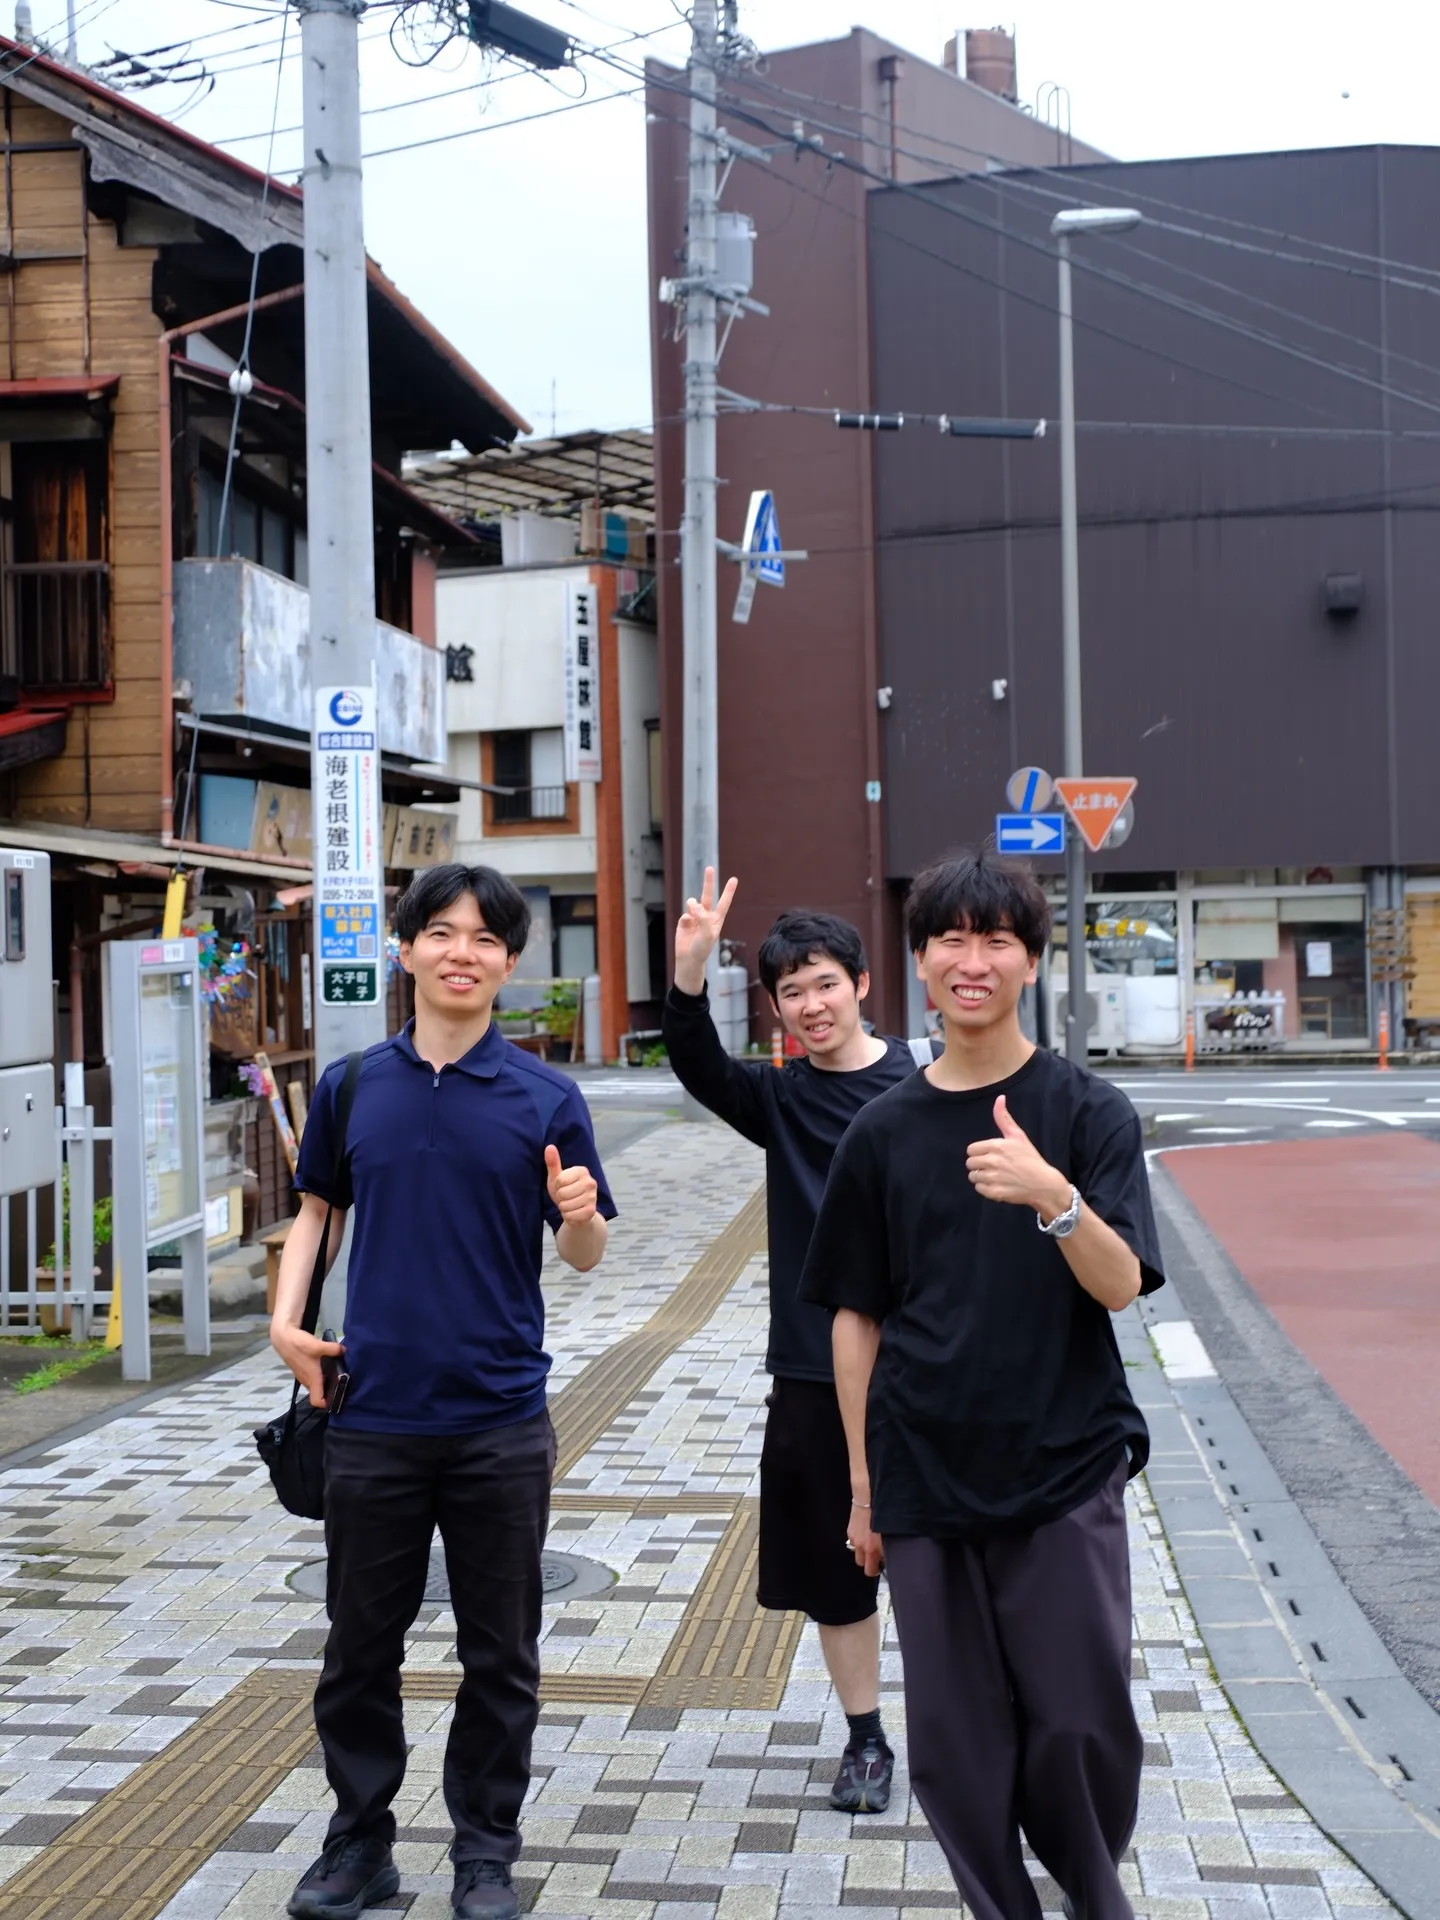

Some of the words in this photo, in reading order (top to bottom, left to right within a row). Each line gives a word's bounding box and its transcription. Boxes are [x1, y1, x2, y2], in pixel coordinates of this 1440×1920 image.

[1072, 792, 1119, 811] 止まれ
[325, 755, 350, 872] 海老根建設
[331, 971, 368, 985] 大子町
